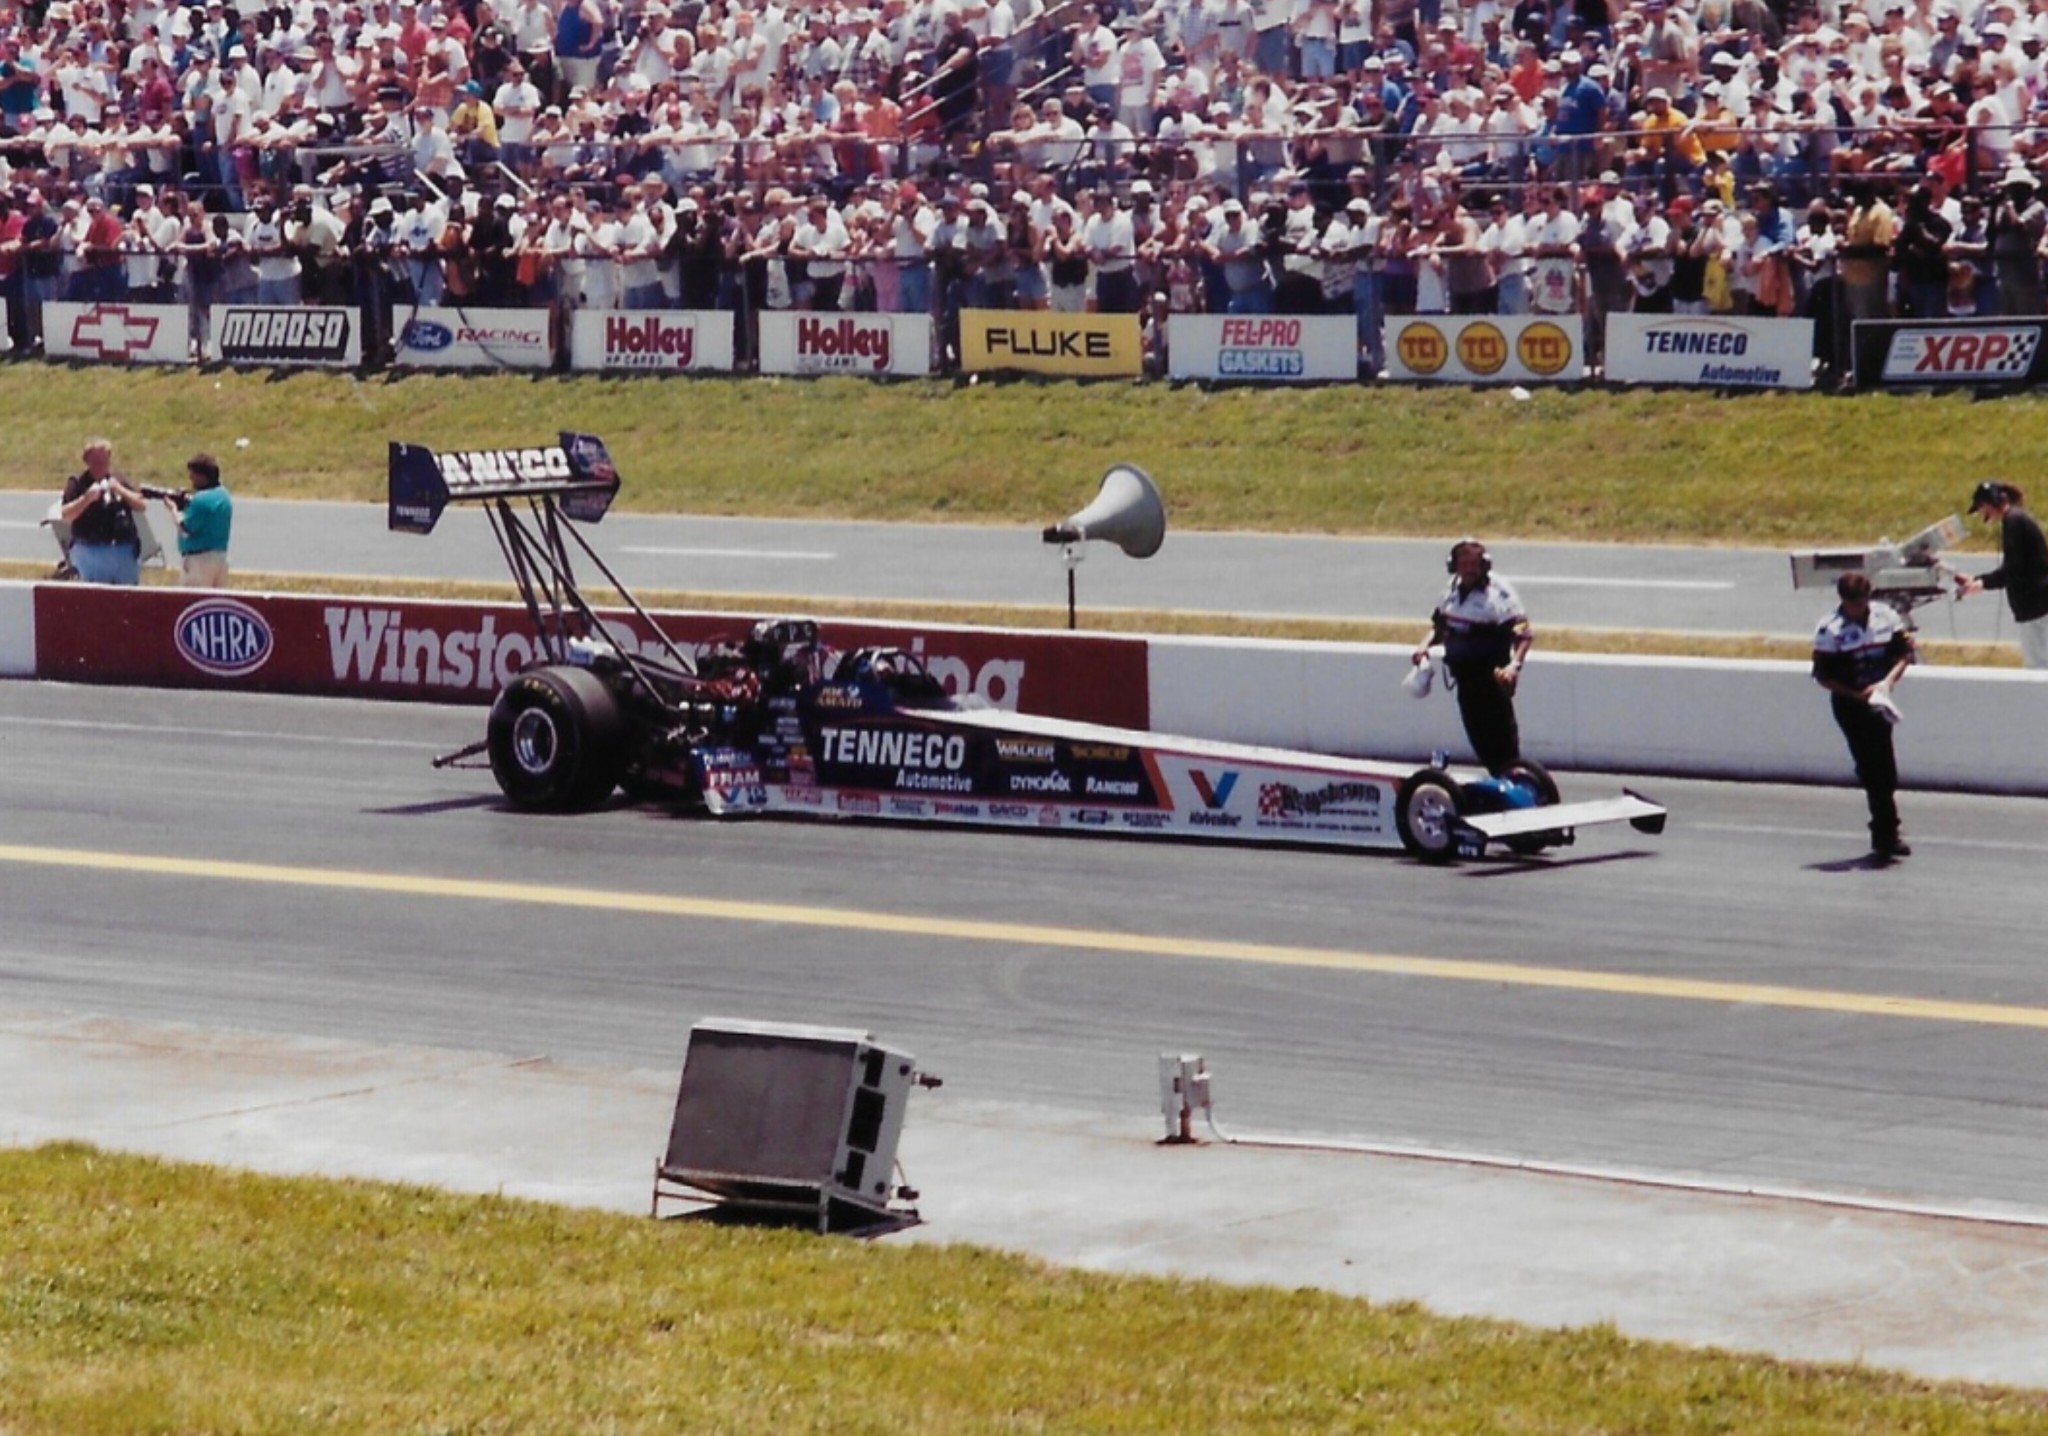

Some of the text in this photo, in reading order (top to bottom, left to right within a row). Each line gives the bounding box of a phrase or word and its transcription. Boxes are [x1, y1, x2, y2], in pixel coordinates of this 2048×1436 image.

[222, 312, 344, 347] MOROSO
[456, 327, 541, 344] RACING
[606, 316, 694, 367] Holley
[1220, 318, 1301, 347] FEL-PRO
[797, 318, 889, 370] Holley
[986, 328, 1111, 358] FLUKE
[1402, 335, 1560, 360] TCI TCI TCI
[1646, 331, 1748, 356] TENNECO
[1914, 334, 2010, 372] XRP
[1221, 350, 1301, 373] GASKETS
[1700, 363, 1781, 383] Automotive
[190, 613, 258, 661] NHRA
[820, 726, 965, 770] TENNECO
[995, 739, 1054, 762] WALKER
[709, 770, 760, 788] FRAM
[896, 768, 973, 792] Automotive
[1086, 776, 1139, 795] RANCHO
